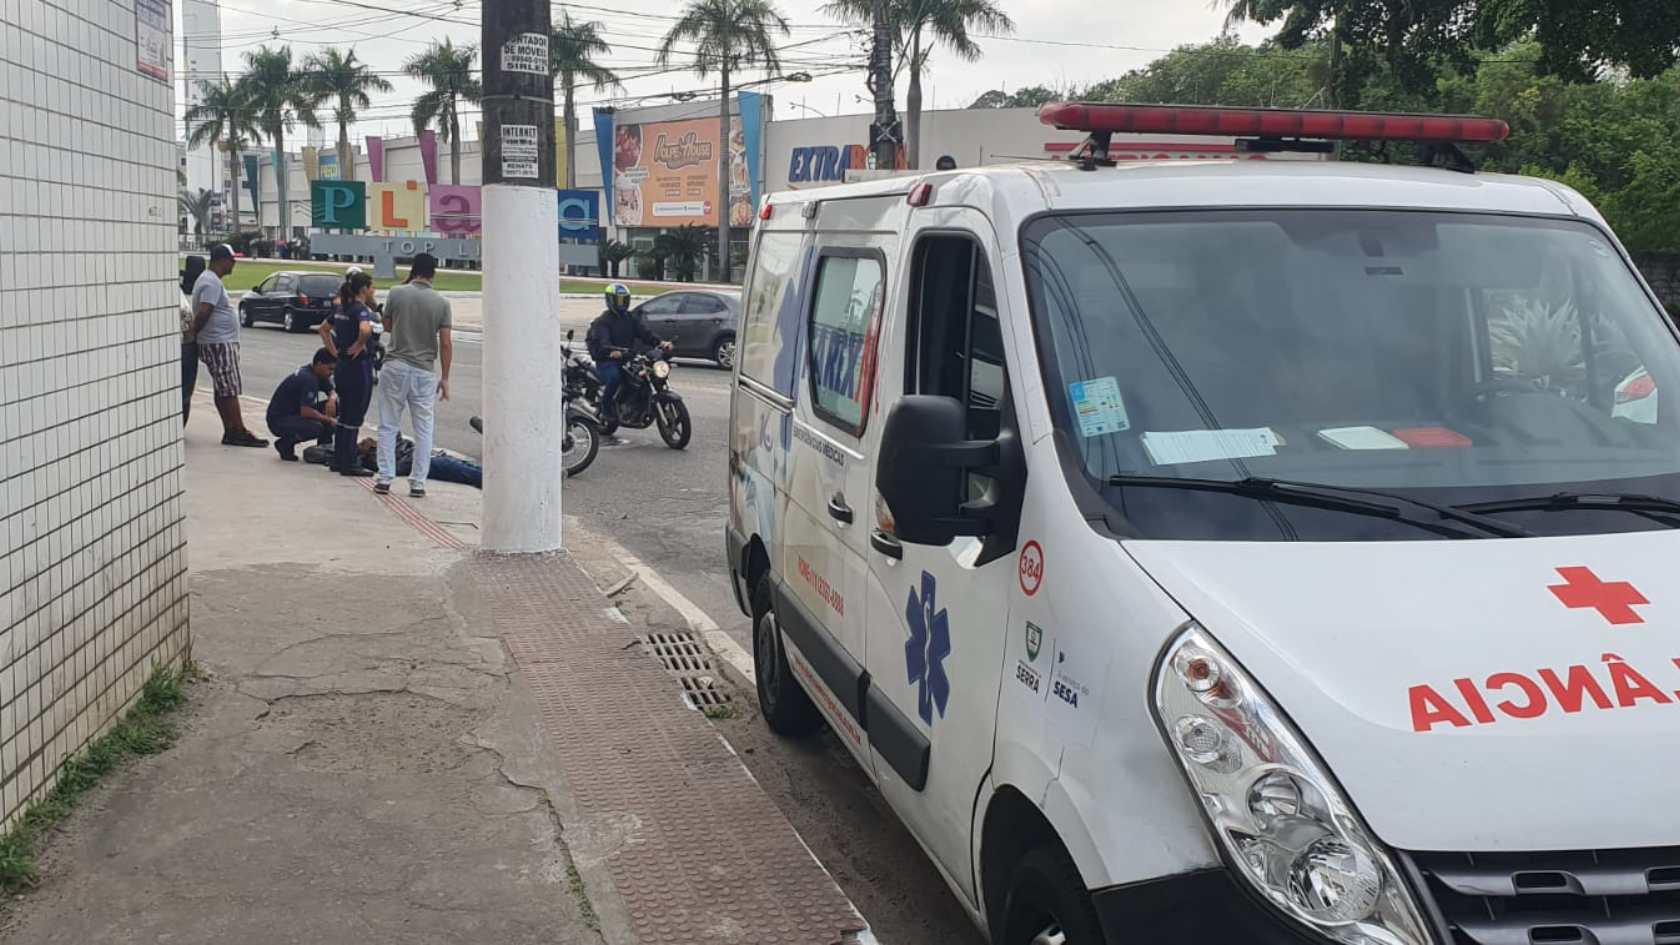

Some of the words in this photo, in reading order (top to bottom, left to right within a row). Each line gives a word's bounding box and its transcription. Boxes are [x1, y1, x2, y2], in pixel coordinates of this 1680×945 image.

[503, 127, 536, 137] INTERNET
[382, 239, 436, 256] TOP
[1021, 555, 1040, 582] 384
[1016, 664, 1040, 696] SERRA
[1053, 680, 1079, 709] SESA
